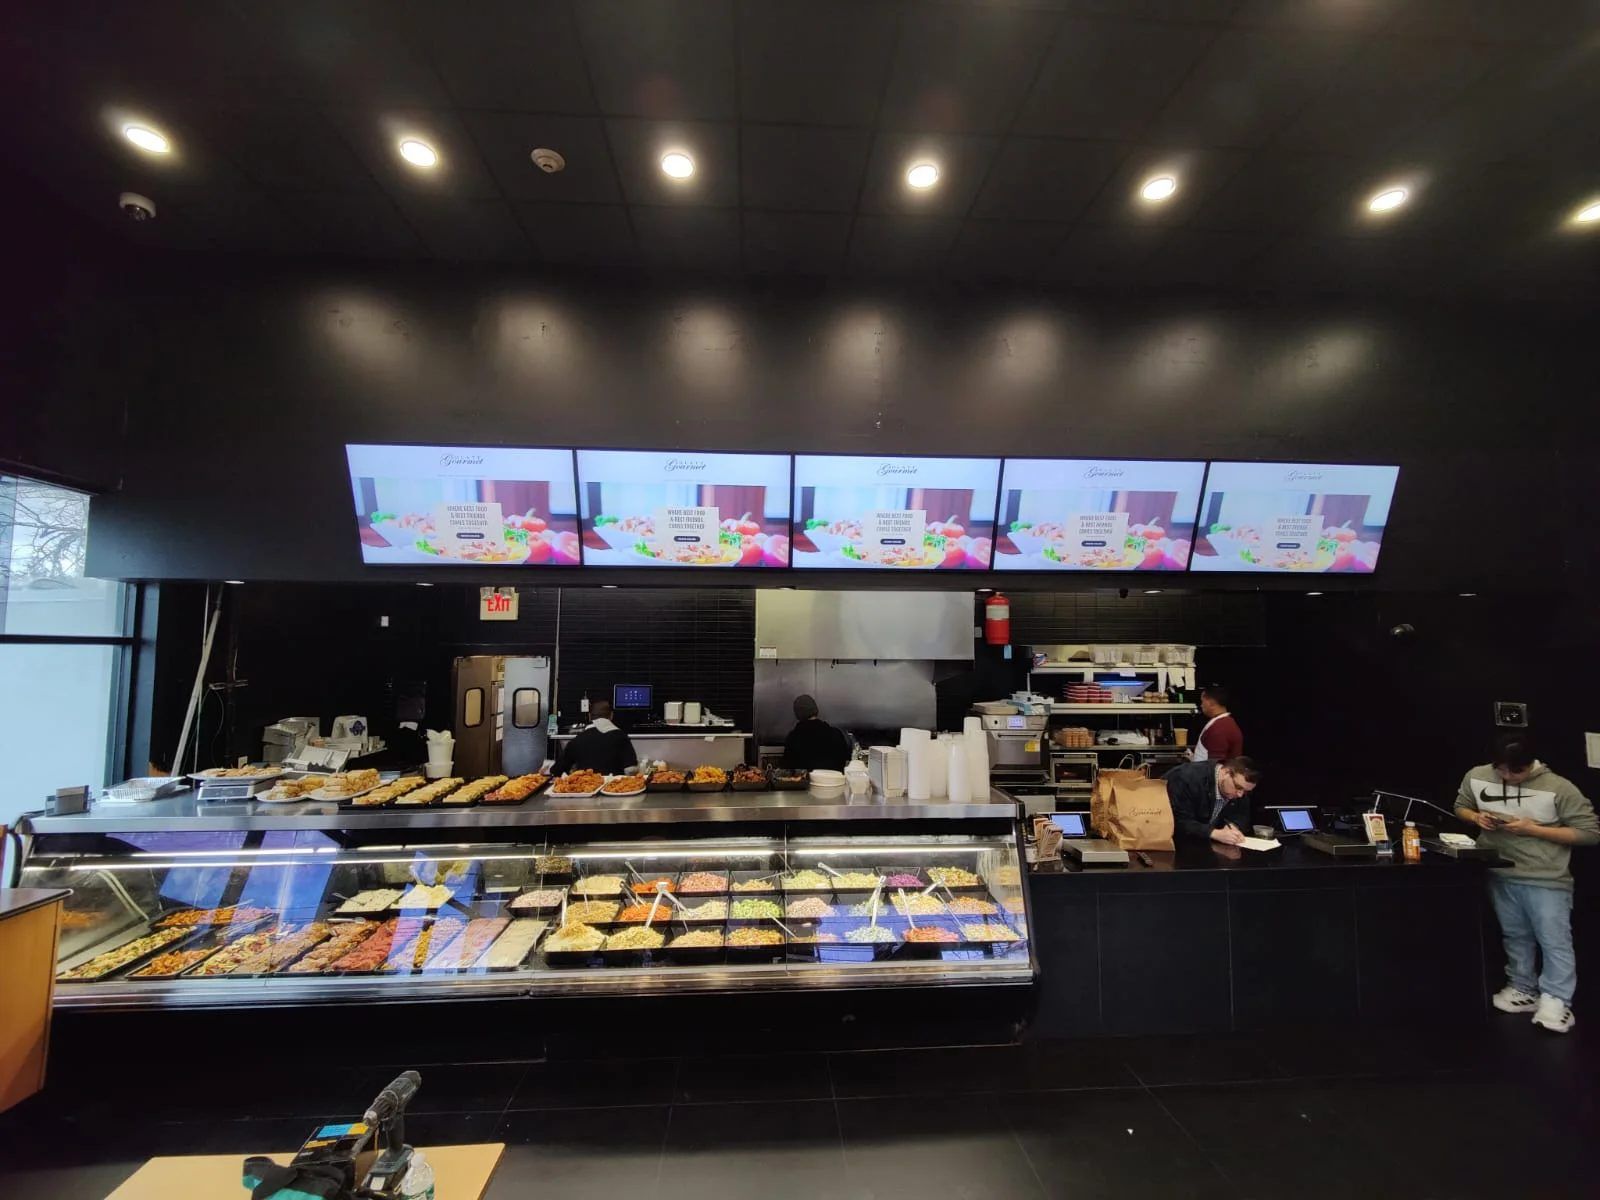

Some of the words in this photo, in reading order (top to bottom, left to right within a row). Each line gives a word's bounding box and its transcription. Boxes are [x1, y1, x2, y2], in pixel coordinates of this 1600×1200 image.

[664, 459, 706, 471] Gourmet
[877, 463, 918, 476] Gourmet
[487, 594, 510, 612] EXIT
